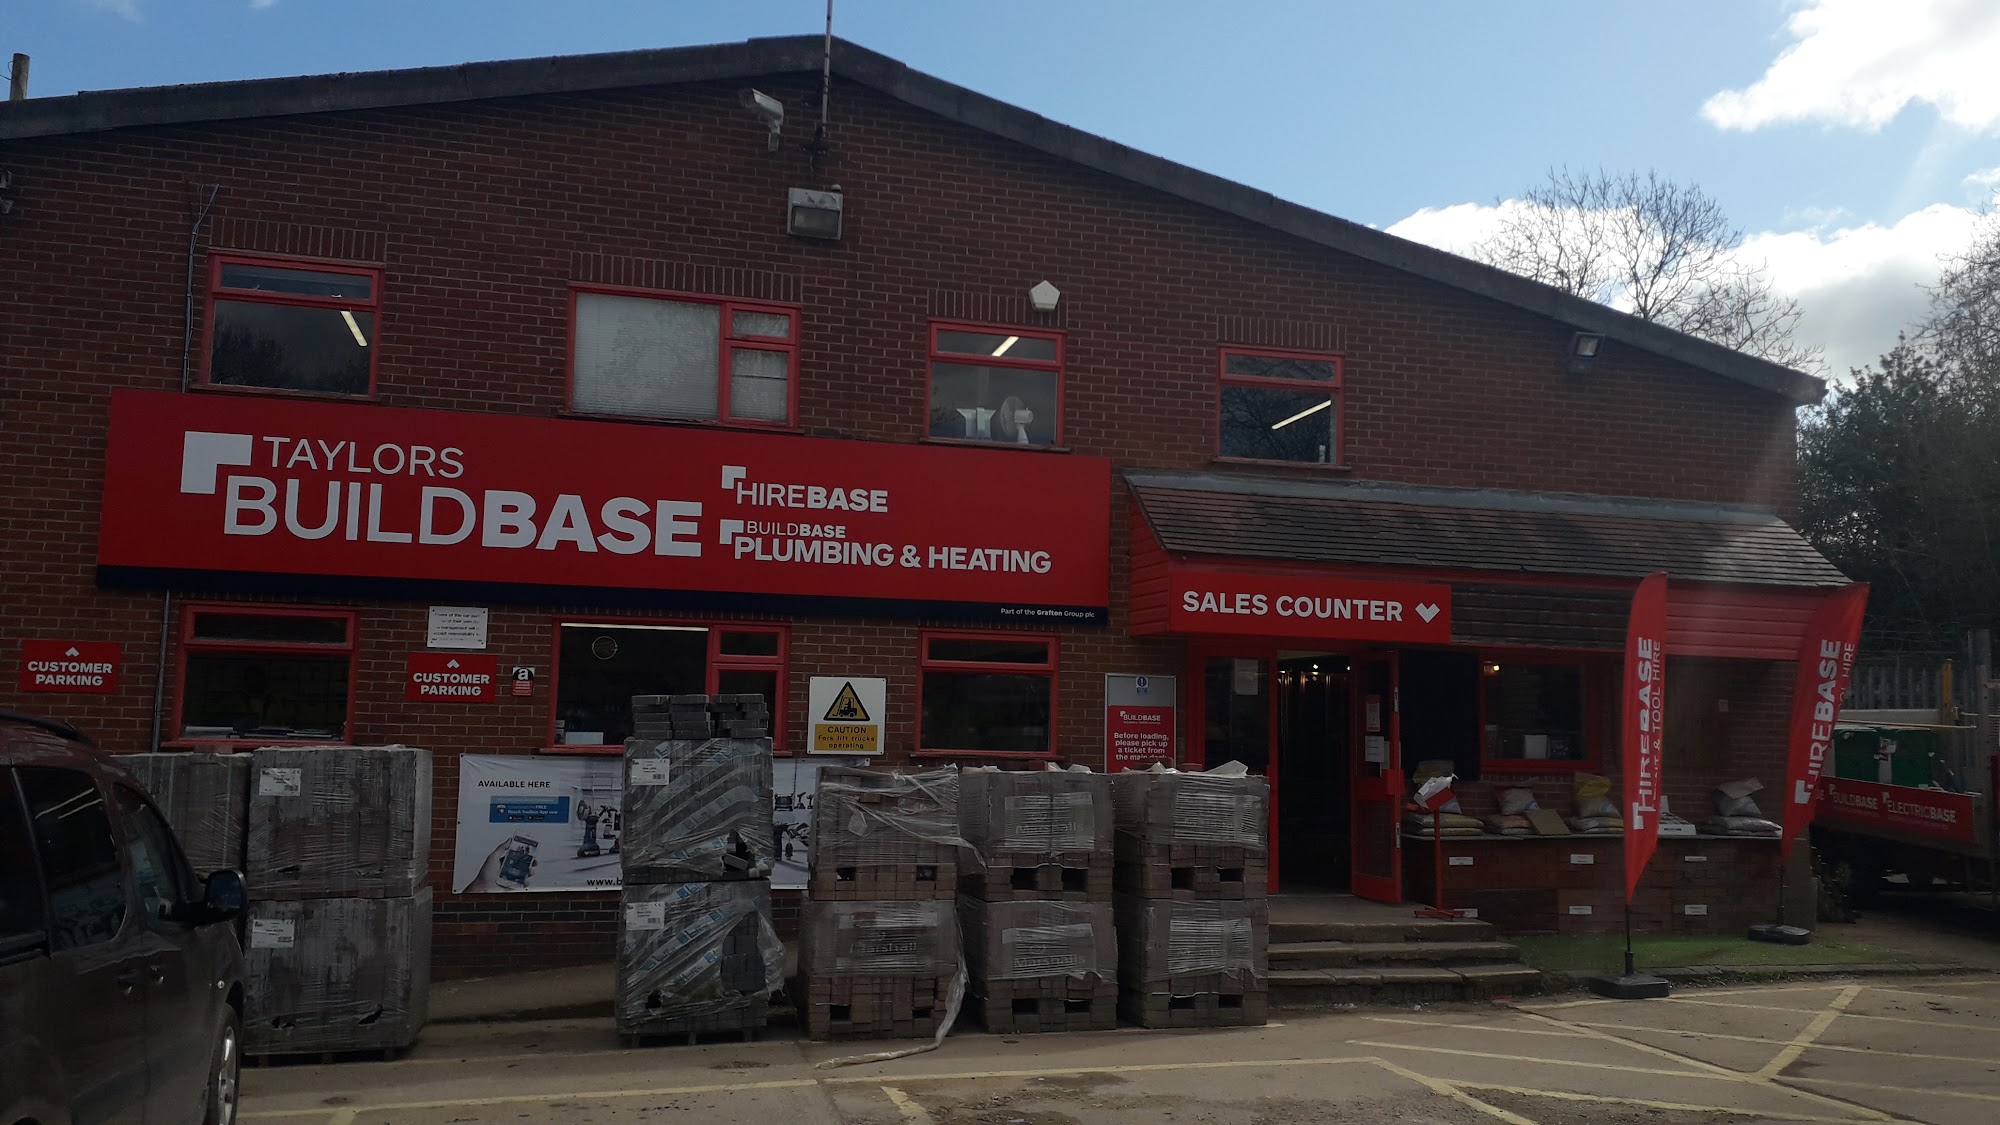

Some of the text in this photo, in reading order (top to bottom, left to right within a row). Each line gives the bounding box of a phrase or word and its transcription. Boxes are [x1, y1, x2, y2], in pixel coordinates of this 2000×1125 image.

[262, 435, 466, 479] TAYLORS
[736, 481, 889, 513] HIREBASE
[223, 475, 703, 558] BUILDBASE
[746, 520, 847, 539] BUILDBASE
[734, 538, 1053, 575] PLUMBING & HEATING
[1000, 607, 1015, 615] Part
[1024, 608, 1035, 616] the
[1036, 609, 1063, 617] Grafton
[1063, 610, 1084, 618] Group
[1084, 611, 1095, 619] plc
[1182, 590, 1403, 622] SALES COUNTER
[27, 661, 113, 674] CUSTOMER
[1653, 641, 1662, 678] HIRE
[1842, 643, 1856, 679] HIRE
[35, 673, 103, 686] PARKING
[413, 672, 490, 685] CUSTOMER
[518, 668, 529, 681] a
[420, 684, 482, 697] PARKING
[1651, 686, 1662, 733] TOOL
[827, 726, 867, 734] CAUTION
[1637, 636, 1657, 814] HIREBASE
[1115, 739, 1140, 747] please
[1140, 733, 1169, 741] loading,
[1653, 738, 1661, 751] &
[478, 780, 525, 788] AVAILABLE
[1833, 792, 1879, 810] BUILDBASE
[1888, 799, 1958, 824] ELECTRICBASE
